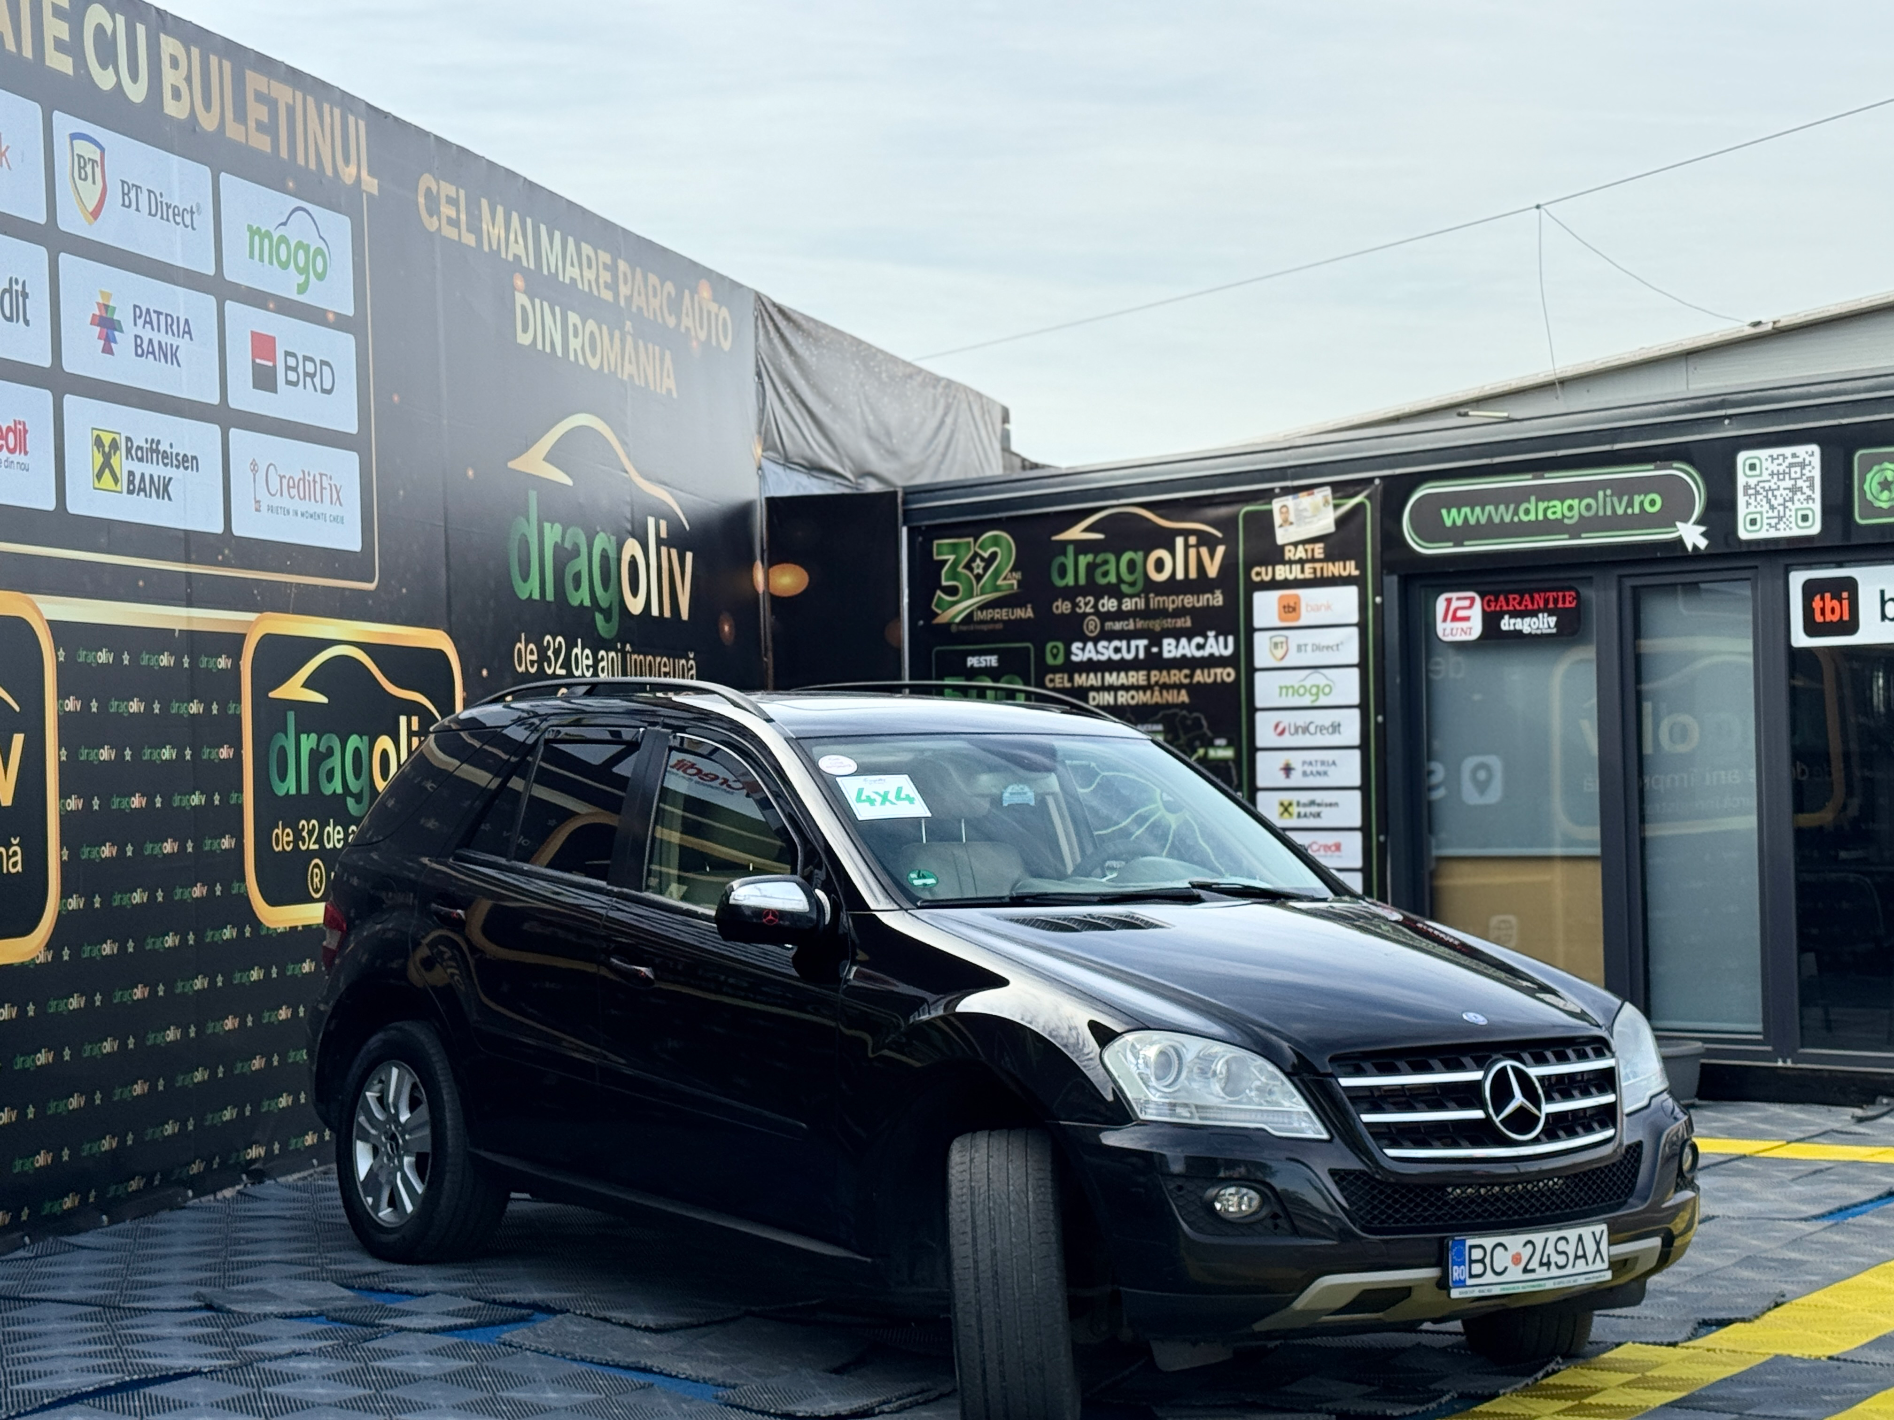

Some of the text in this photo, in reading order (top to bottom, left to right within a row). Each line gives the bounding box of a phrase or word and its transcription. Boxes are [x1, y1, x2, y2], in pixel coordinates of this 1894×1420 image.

[83, 3, 149, 103] CU
[159, 32, 378, 196] BULETINUL
[76, 153, 99, 185] BT
[119, 179, 142, 213] BT
[247, 222, 328, 296] mogo
[417, 173, 733, 352] CEL MAI MARE PARC AUTO
[133, 303, 194, 342] PATRIA
[133, 334, 182, 368] BANK
[514, 290, 678, 399] DIN ROMÂNIA
[283, 350, 336, 396] BRD
[125, 435, 200, 473] Raiffeisen
[126, 470, 173, 502] BANK
[265, 462, 343, 507] CreditFix
[1440, 489, 1662, 527] www.dragoliv.ro
[508, 490, 693, 640] dragoliv
[1050, 536, 1226, 595] dragoliv
[1284, 543, 1324, 561] RATE
[931, 530, 1017, 615] 32
[1251, 561, 1360, 582] CU BULETINUL
[1052, 590, 1224, 614] de 32 de ani împreună
[1282, 601, 1333, 614] tbi bank
[1442, 596, 1476, 623] 12
[1483, 591, 1577, 612] GARANTIE
[1812, 592, 1849, 624] tbi
[1442, 627, 1473, 637] LUNI
[1500, 613, 1557, 634] dragoliv
[514, 633, 697, 680] de 32 de ani împreună
[1070, 639, 1148, 662] SASCUT
[1162, 630, 1234, 658] BACĂU
[1296, 643, 1309, 653] BT
[76, 648, 232, 672] dragoliv dragoliv dragoliv
[967, 655, 999, 668] PESTE
[1044, 667, 1236, 688] CEL MAI MARE PARC AUTO
[108, 697, 145, 717] dragoliv
[170, 699, 204, 717] dragoliv
[1088, 687, 1190, 706] DIN ROMÂNIA
[1279, 683, 1332, 704] mogo
[1288, 722, 1342, 736] UniCredit
[78, 744, 234, 765] dragoliv dragoliv dragoliv
[269, 710, 425, 817] dragoli
[1302, 760, 1337, 768] PATRIA
[1302, 770, 1329, 778] BANK
[110, 792, 147, 813] dragoliv
[172, 790, 206, 810] dragoliv
[1297, 811, 1322, 819] BANK
[80, 834, 236, 862] dragoliv dragoliv dragoliv
[272, 821, 293, 852] de
[299, 820, 319, 850] 32
[324, 818, 344, 849] de
[112, 888, 148, 908] dragoliv
[173, 882, 208, 902] dragoliv
[1453, 1265, 1466, 1281] RO
